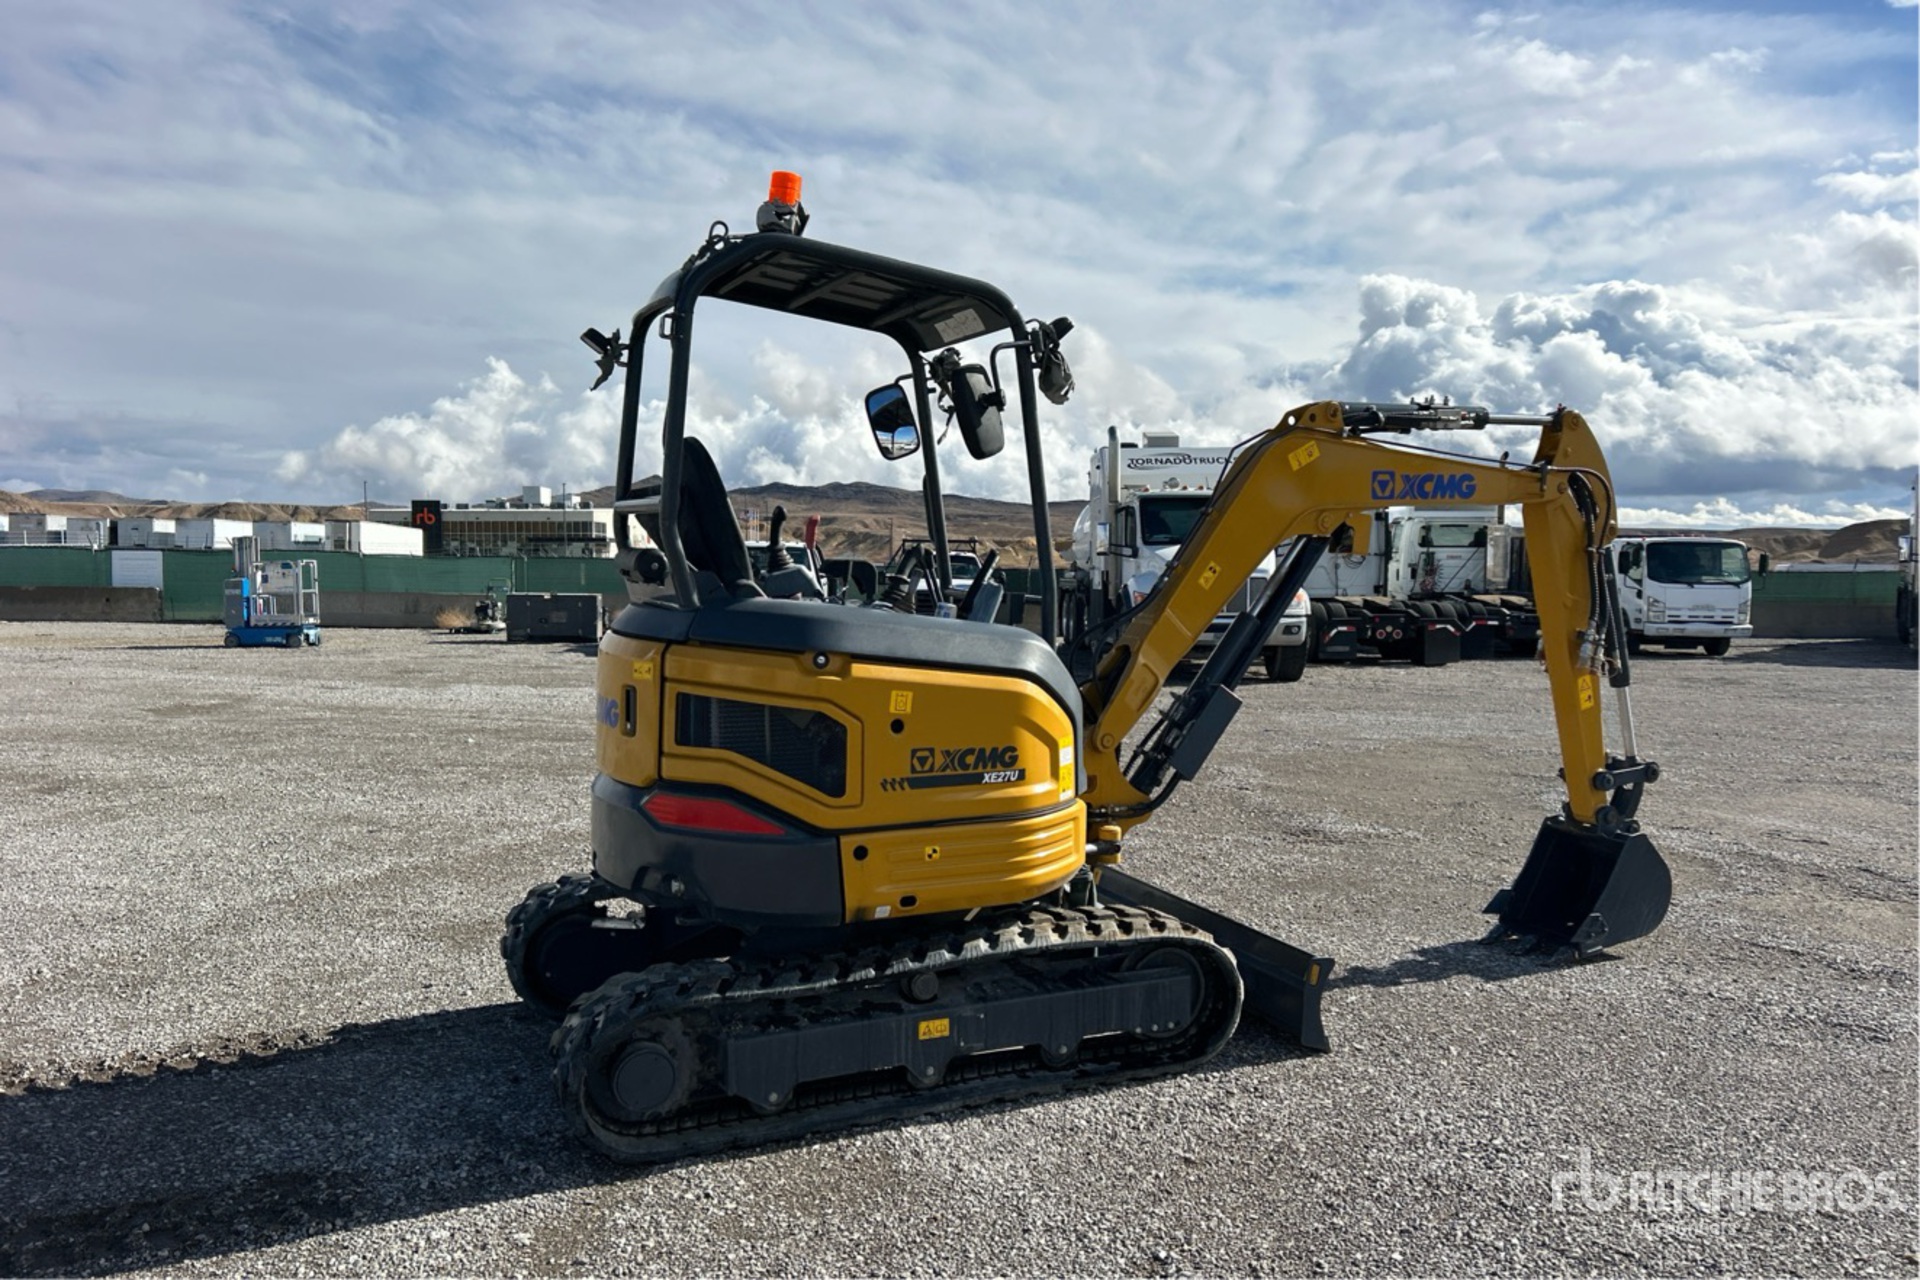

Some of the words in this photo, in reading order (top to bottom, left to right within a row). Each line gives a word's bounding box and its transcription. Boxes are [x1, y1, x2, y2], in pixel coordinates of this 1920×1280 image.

[1397, 473, 1477, 500] XCMG
[416, 507, 436, 525] rb
[935, 746, 1019, 772] XCMG
[982, 771, 1019, 784] XE27U
